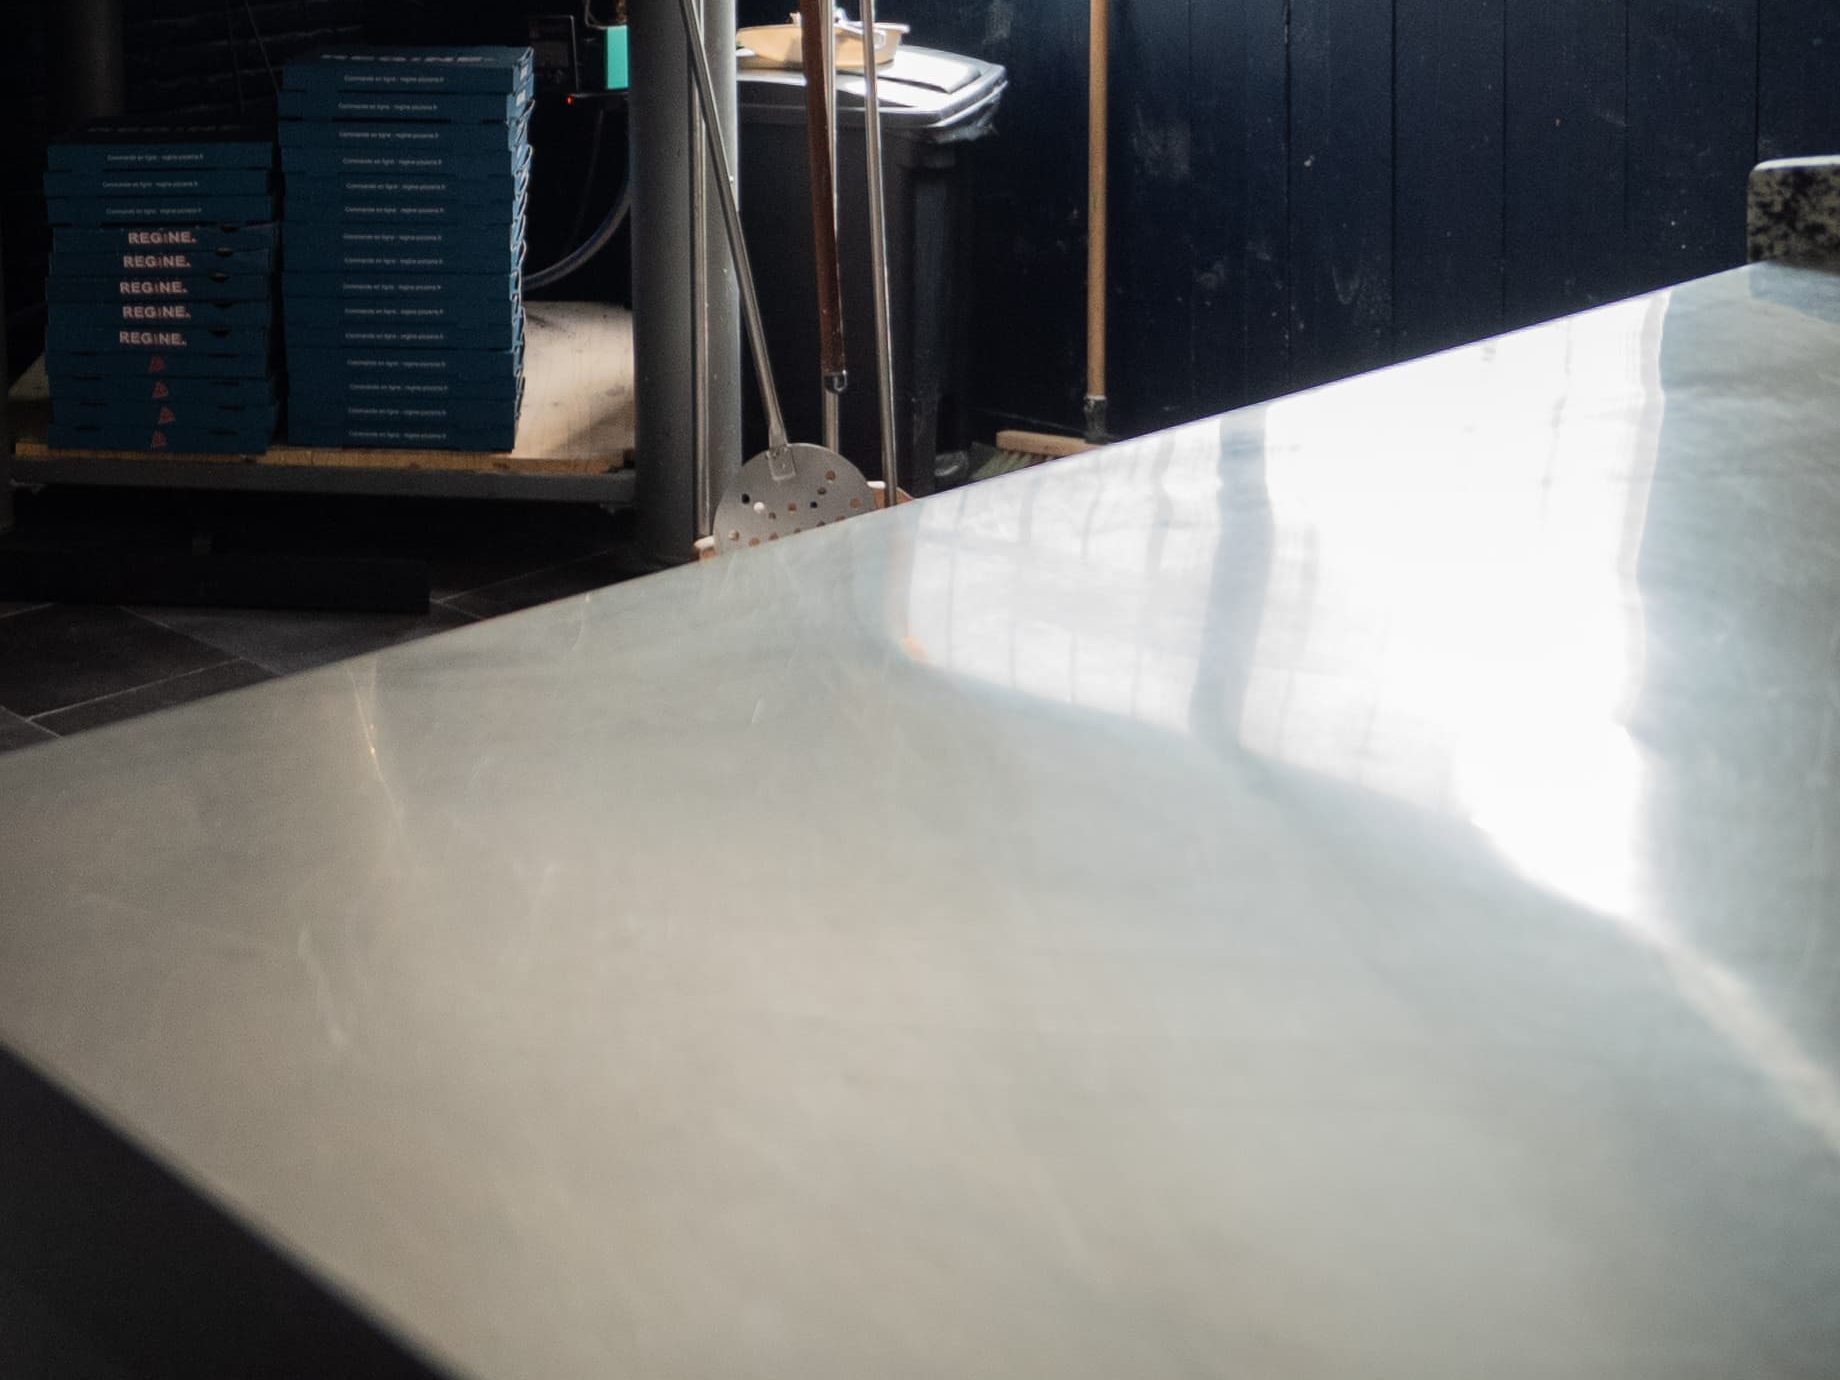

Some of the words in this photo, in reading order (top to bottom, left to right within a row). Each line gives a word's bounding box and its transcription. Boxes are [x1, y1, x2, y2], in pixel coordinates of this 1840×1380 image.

[128, 231, 197, 245] REGINE.
[123, 255, 191, 268] REGINE.
[120, 281, 188, 294] REGINE.
[122, 306, 191, 319] REGINE.
[119, 331, 187, 346] REGINE.
